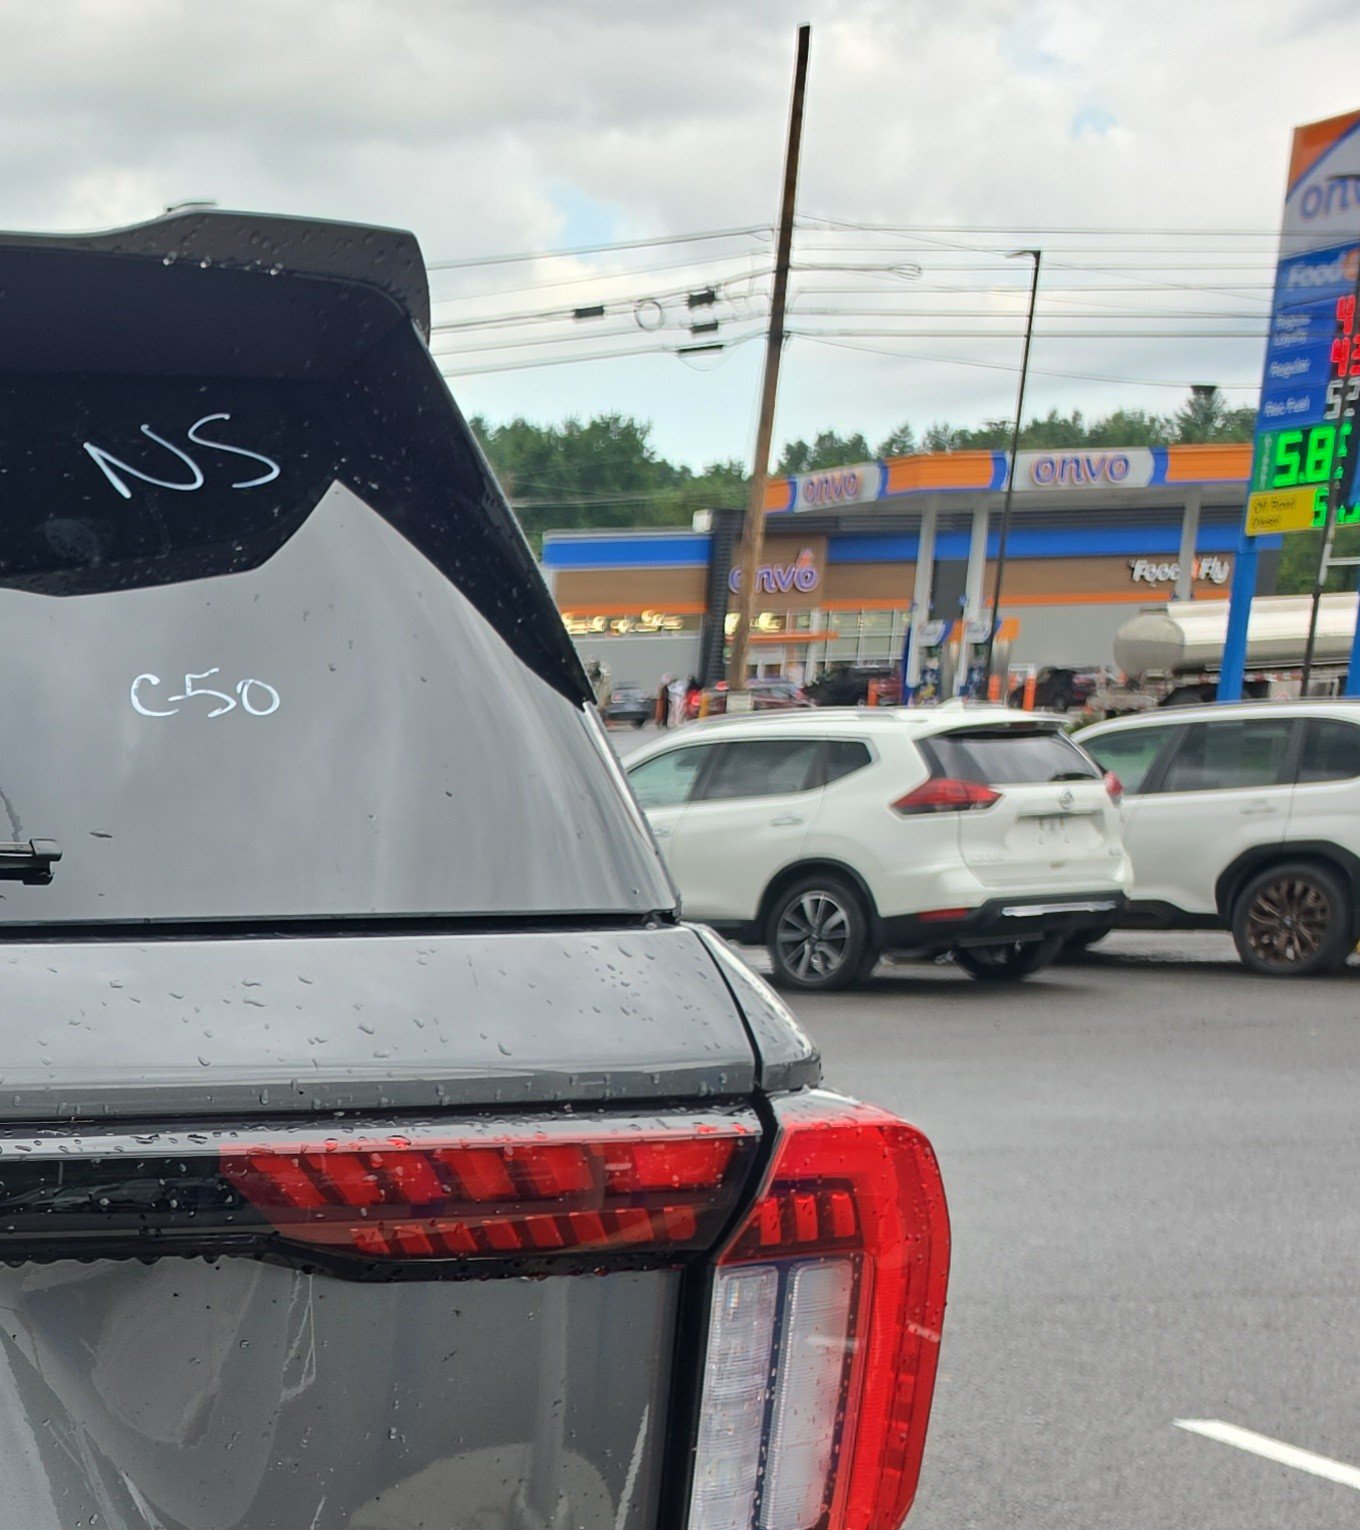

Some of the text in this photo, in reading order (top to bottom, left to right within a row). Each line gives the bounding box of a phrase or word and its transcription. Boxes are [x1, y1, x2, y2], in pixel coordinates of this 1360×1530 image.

[1300, 176, 1360, 220] on
[83, 413, 280, 499] NS
[1032, 454, 1130, 485] onvo
[803, 470, 862, 504] onvo
